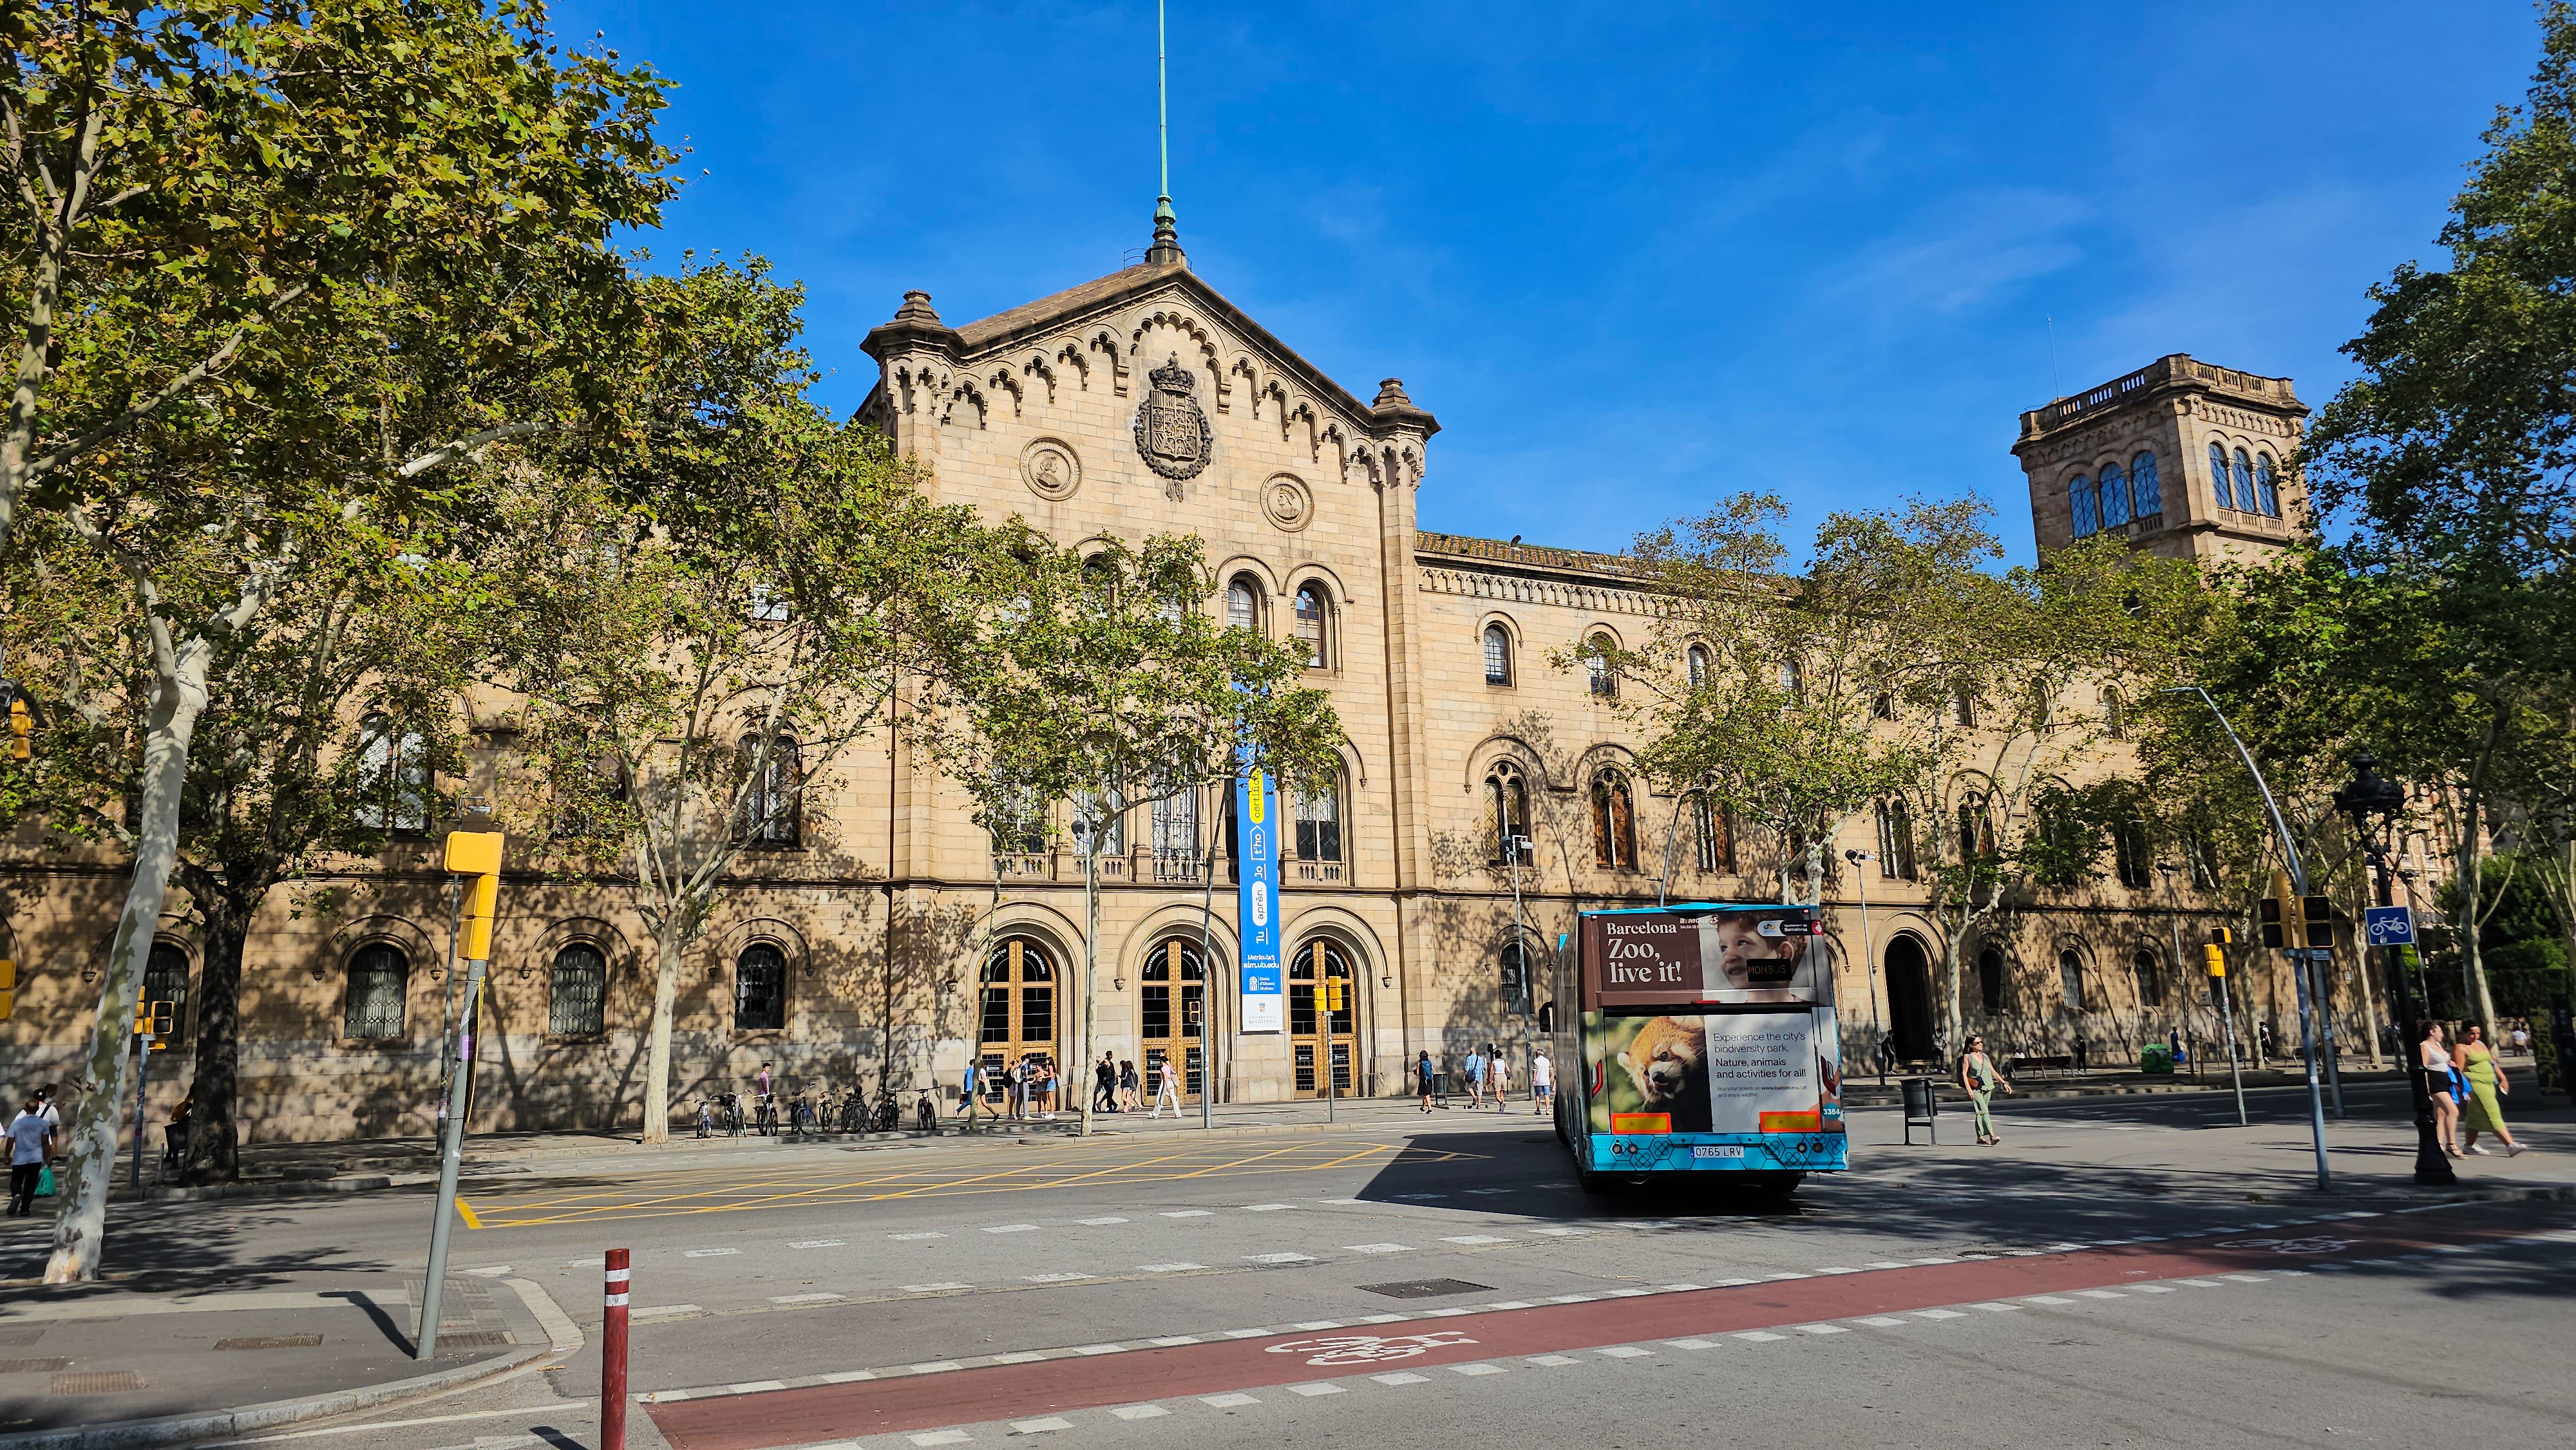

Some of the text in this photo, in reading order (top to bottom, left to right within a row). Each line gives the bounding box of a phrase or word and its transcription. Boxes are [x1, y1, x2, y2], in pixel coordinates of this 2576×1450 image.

[1255, 866, 1263, 878] Jo
[1606, 921, 1677, 935] Barcelona
[1256, 931, 1265, 944] Tu
[1607, 938, 1660, 961] Zoo,
[1609, 961, 1682, 983] live it!
[1748, 965, 1787, 974] MONBUS
[1714, 1031, 1806, 1043] Experience the city's
[1714, 1043, 1789, 1055] biodiversity park.
[1716, 1057, 1786, 1068] Nature, animals
[1716, 1068, 1806, 1078] and activities for all!
[1696, 1147, 1741, 1156] 0765 LRV
